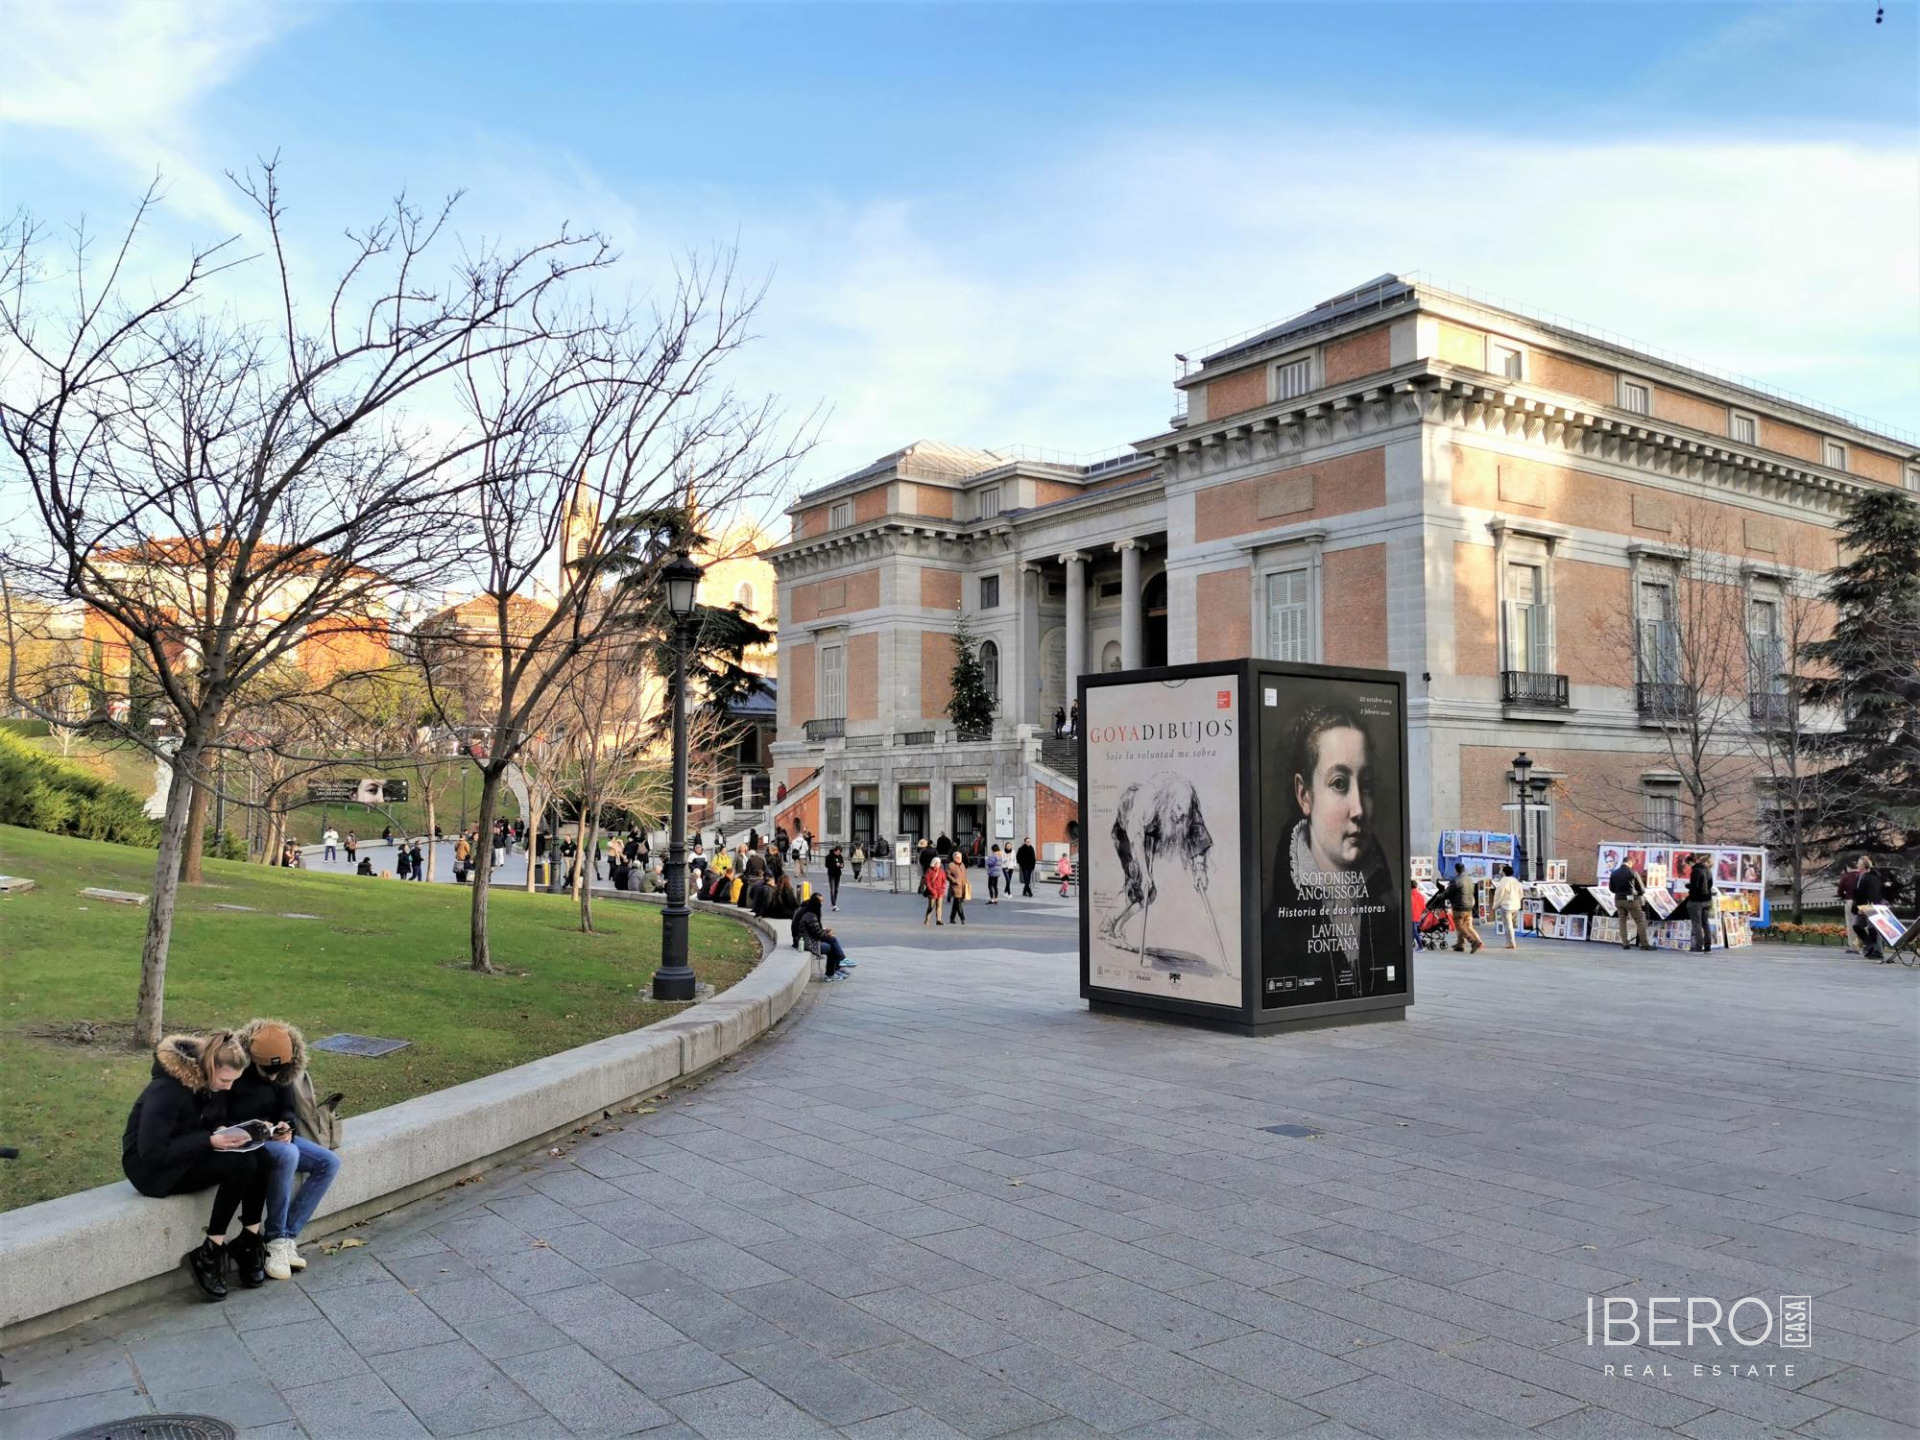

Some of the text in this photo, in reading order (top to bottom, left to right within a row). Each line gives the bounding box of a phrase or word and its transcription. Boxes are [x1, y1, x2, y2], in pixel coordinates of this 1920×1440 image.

[1302, 871, 1366, 886] SOFONISBA
[1297, 885, 1370, 901] ANGUISSOLA
[1278, 904, 1386, 918] Historia de dos pintoras
[1312, 923, 1356, 939] LAVINIA
[1307, 937, 1360, 954] FONTANA
